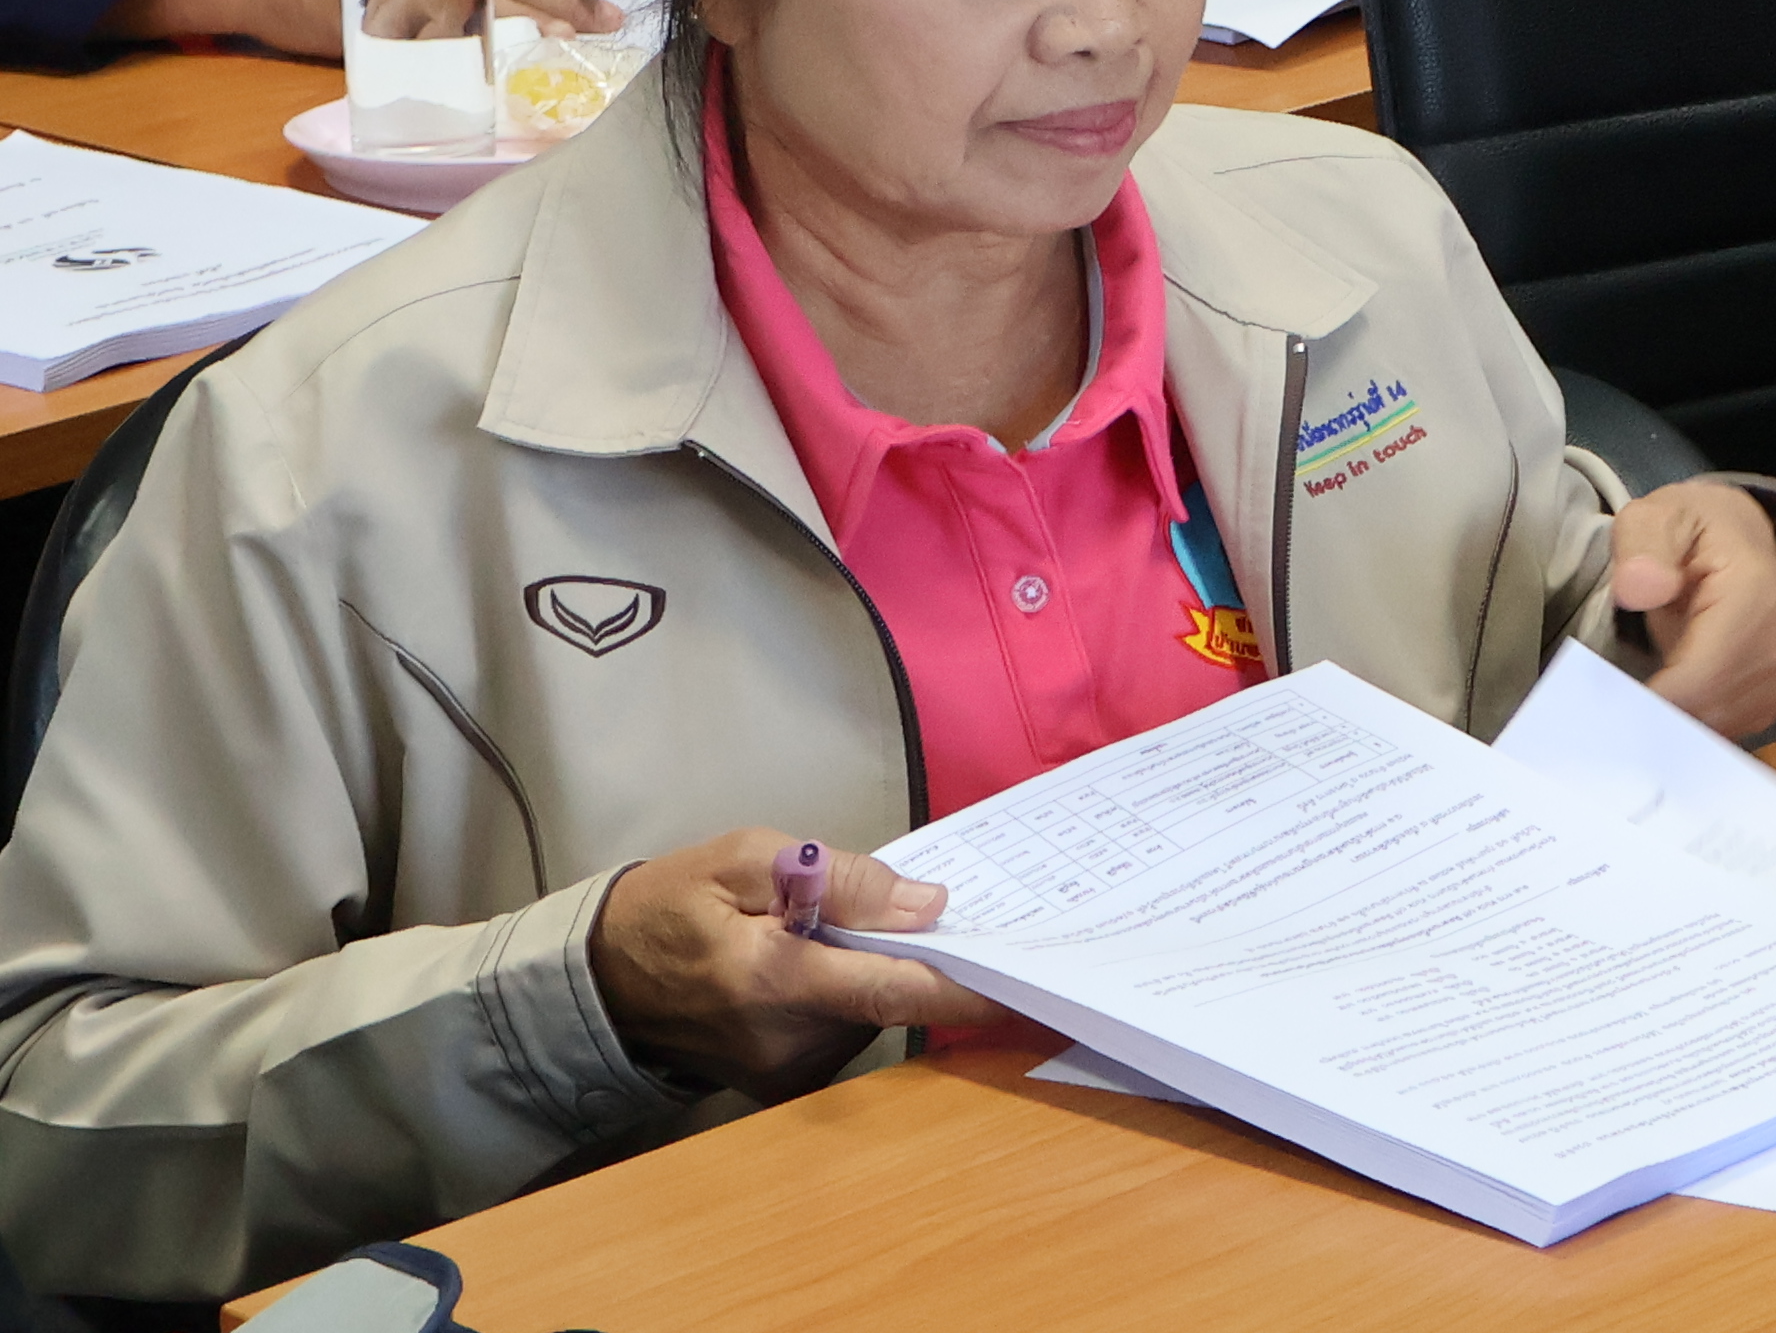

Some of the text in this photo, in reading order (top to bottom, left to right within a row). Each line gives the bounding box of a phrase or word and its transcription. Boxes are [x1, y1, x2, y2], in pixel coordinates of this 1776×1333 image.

[1304, 423, 1428, 499] Keep in touch
